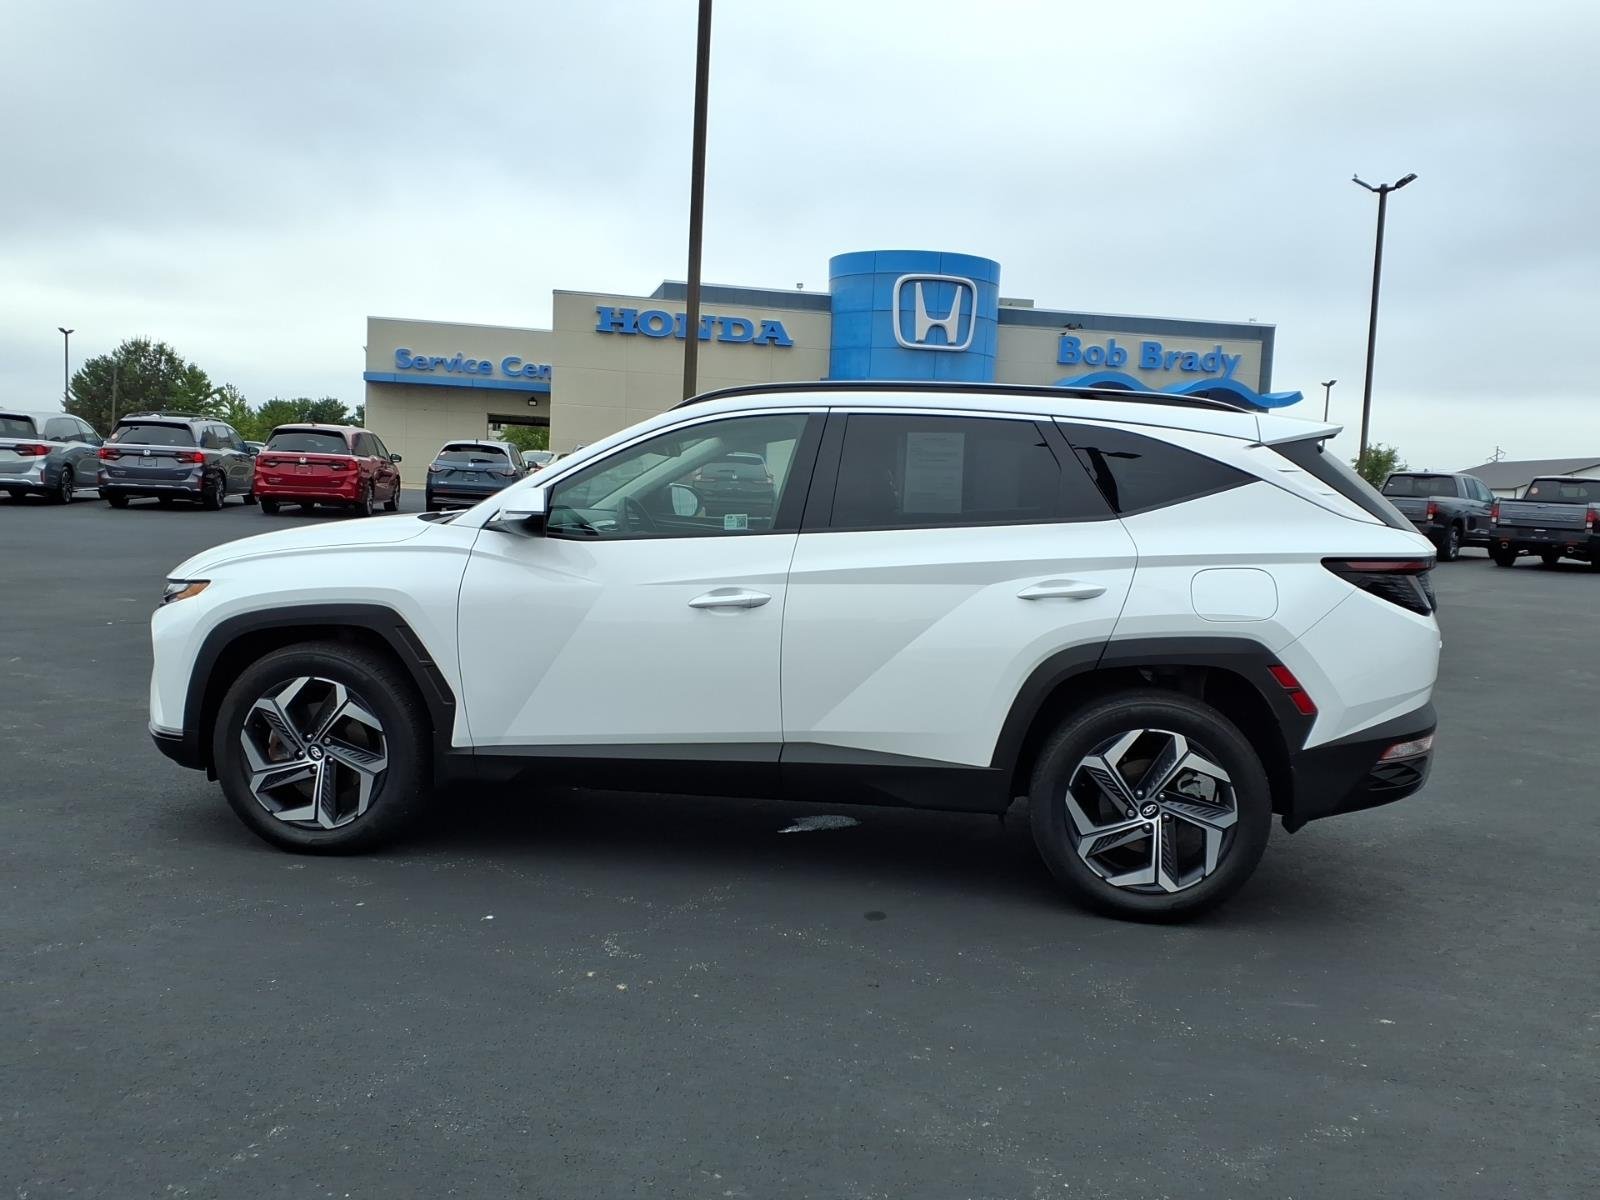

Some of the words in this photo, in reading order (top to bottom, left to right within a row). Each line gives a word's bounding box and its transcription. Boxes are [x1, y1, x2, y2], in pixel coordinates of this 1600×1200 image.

[595, 306, 793, 347] HONDA
[395, 348, 493, 376] Service
[1057, 335, 1128, 368] Bob
[1138, 341, 1241, 379] Brady
